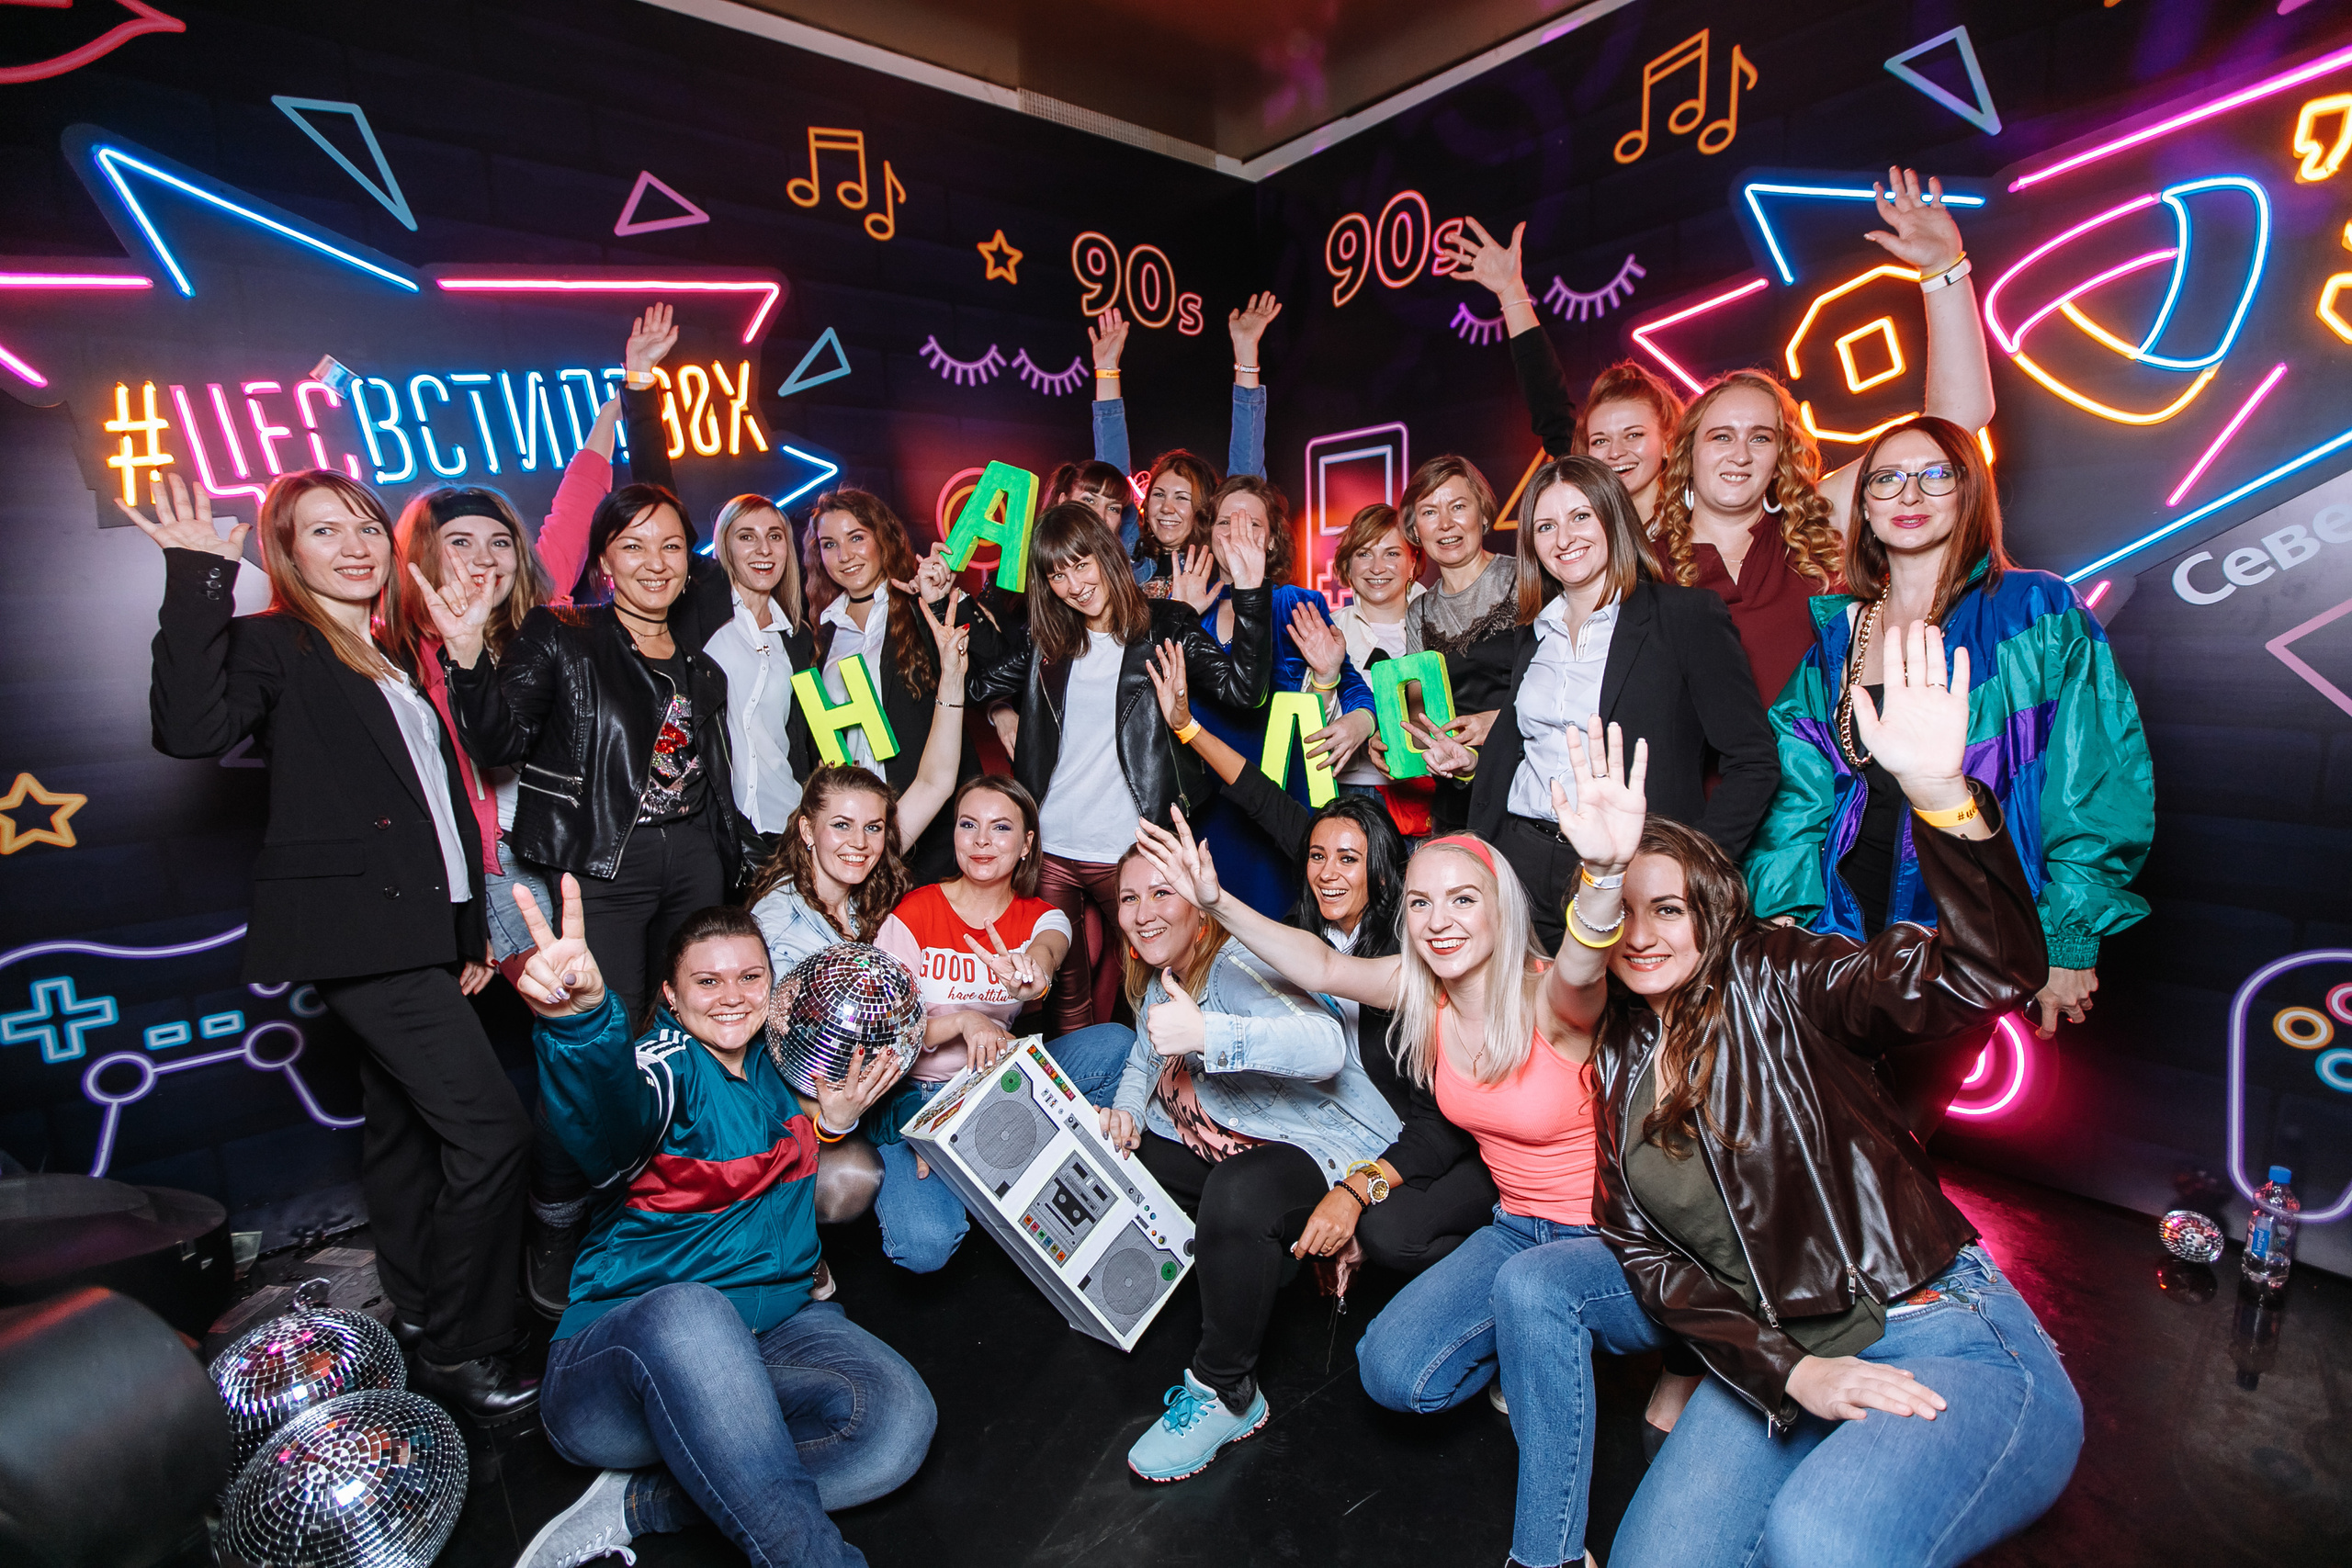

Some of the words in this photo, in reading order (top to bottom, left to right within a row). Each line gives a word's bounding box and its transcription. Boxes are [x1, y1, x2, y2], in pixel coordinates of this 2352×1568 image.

[1071, 231, 1204, 336] 90s
[920, 950, 976, 984] GOOD
[947, 986, 977, 1001] have
